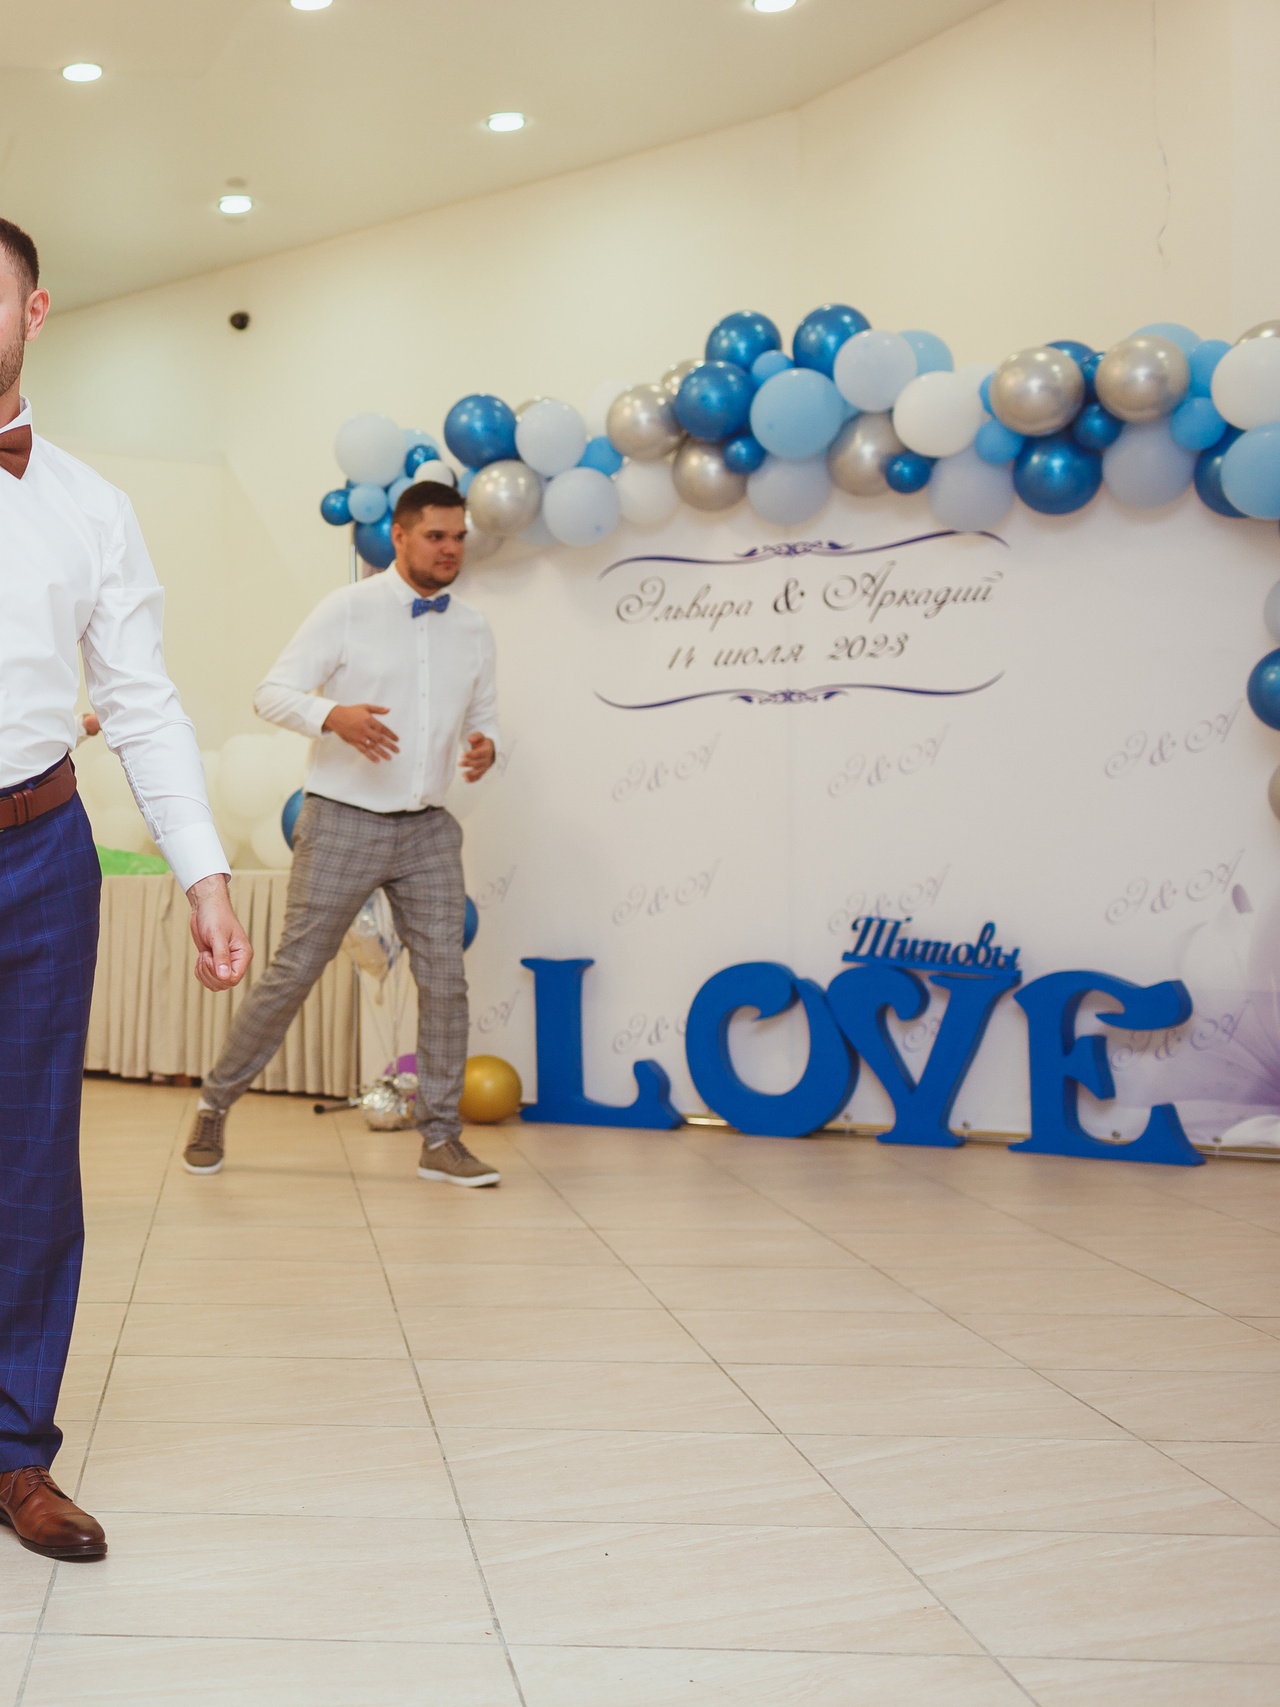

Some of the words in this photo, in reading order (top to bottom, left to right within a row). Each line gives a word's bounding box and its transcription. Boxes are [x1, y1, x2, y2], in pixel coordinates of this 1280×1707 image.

[615, 576, 753, 632] Эльвира
[773, 578, 806, 614] &
[822, 560, 1005, 624] Аркадий
[667, 645, 696, 670] 14
[713, 643, 805, 668] июля
[827, 632, 909, 662] 2023
[520, 957, 1206, 1166] LOVE
